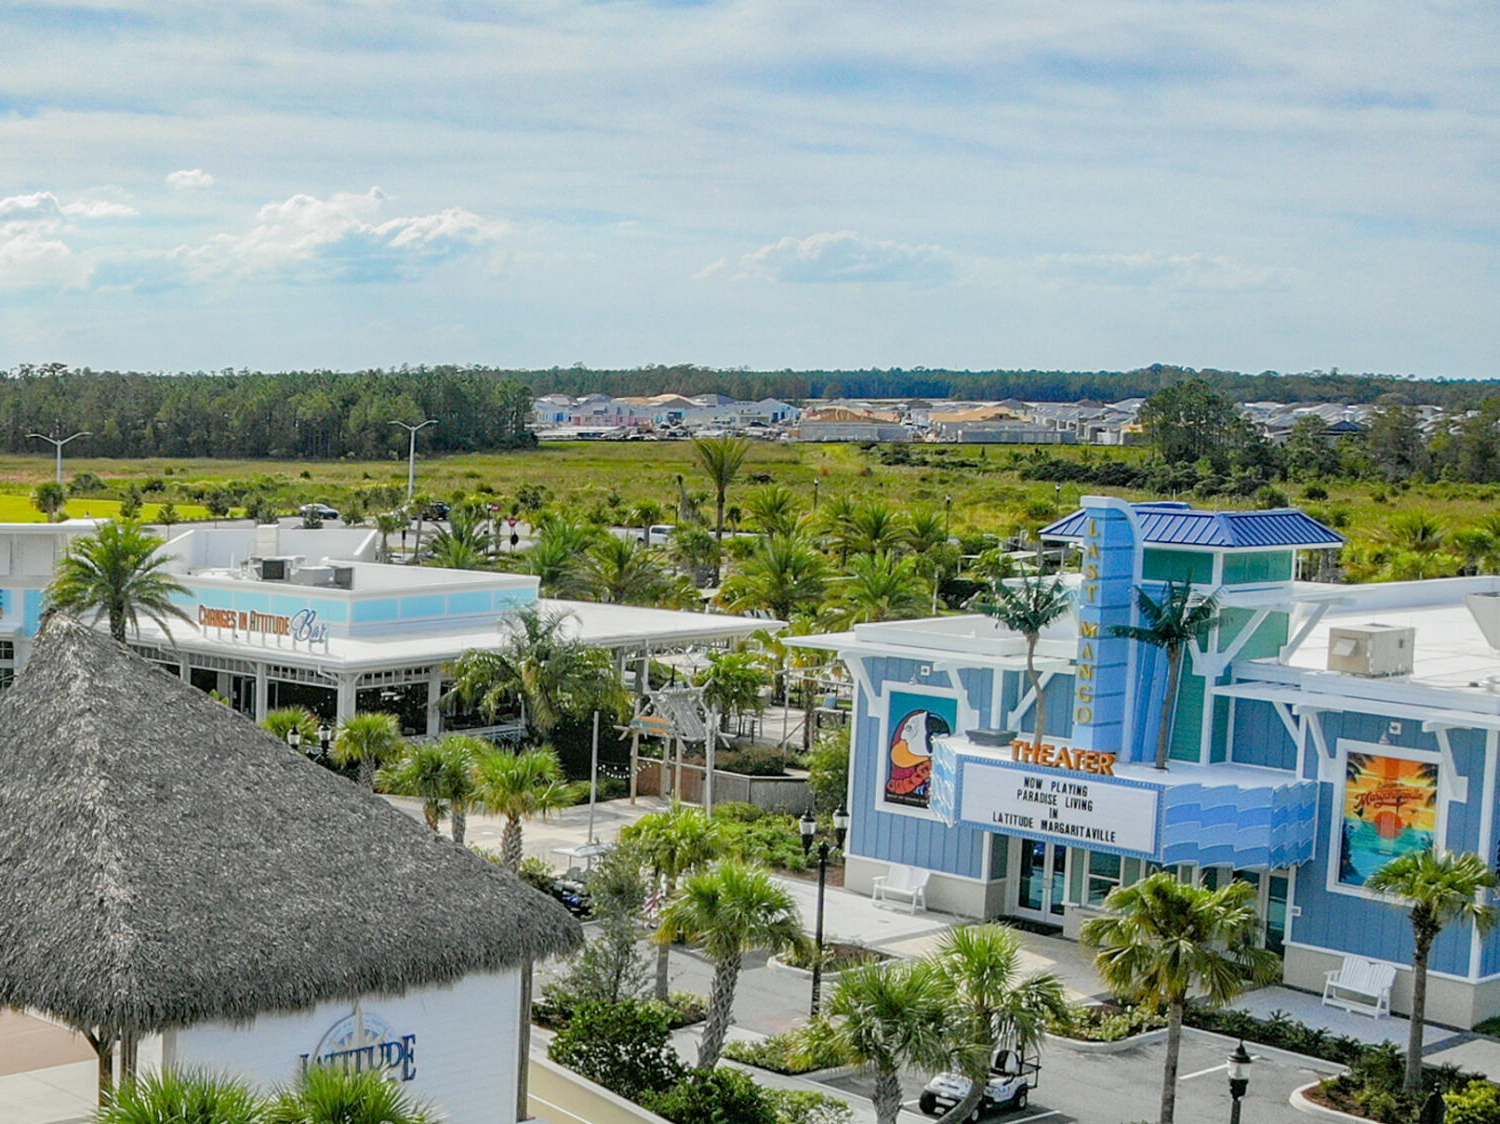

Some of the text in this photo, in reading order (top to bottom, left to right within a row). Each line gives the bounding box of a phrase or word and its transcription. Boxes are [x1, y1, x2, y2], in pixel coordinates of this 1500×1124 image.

[239, 612, 248, 631] IN
[250, 610, 290, 636] ATTITUDE
[291, 608, 327, 643] Bar
[1076, 519, 1100, 724] LAST MANGO
[1010, 740, 1116, 776] THEATER
[1017, 789, 1093, 812] PARADISE LIVING
[1024, 777, 1088, 797] NOW PLAYING
[993, 811, 1116, 843] LATITUDE MARGARITAVILLE
[1049, 807, 1058, 819] IN
